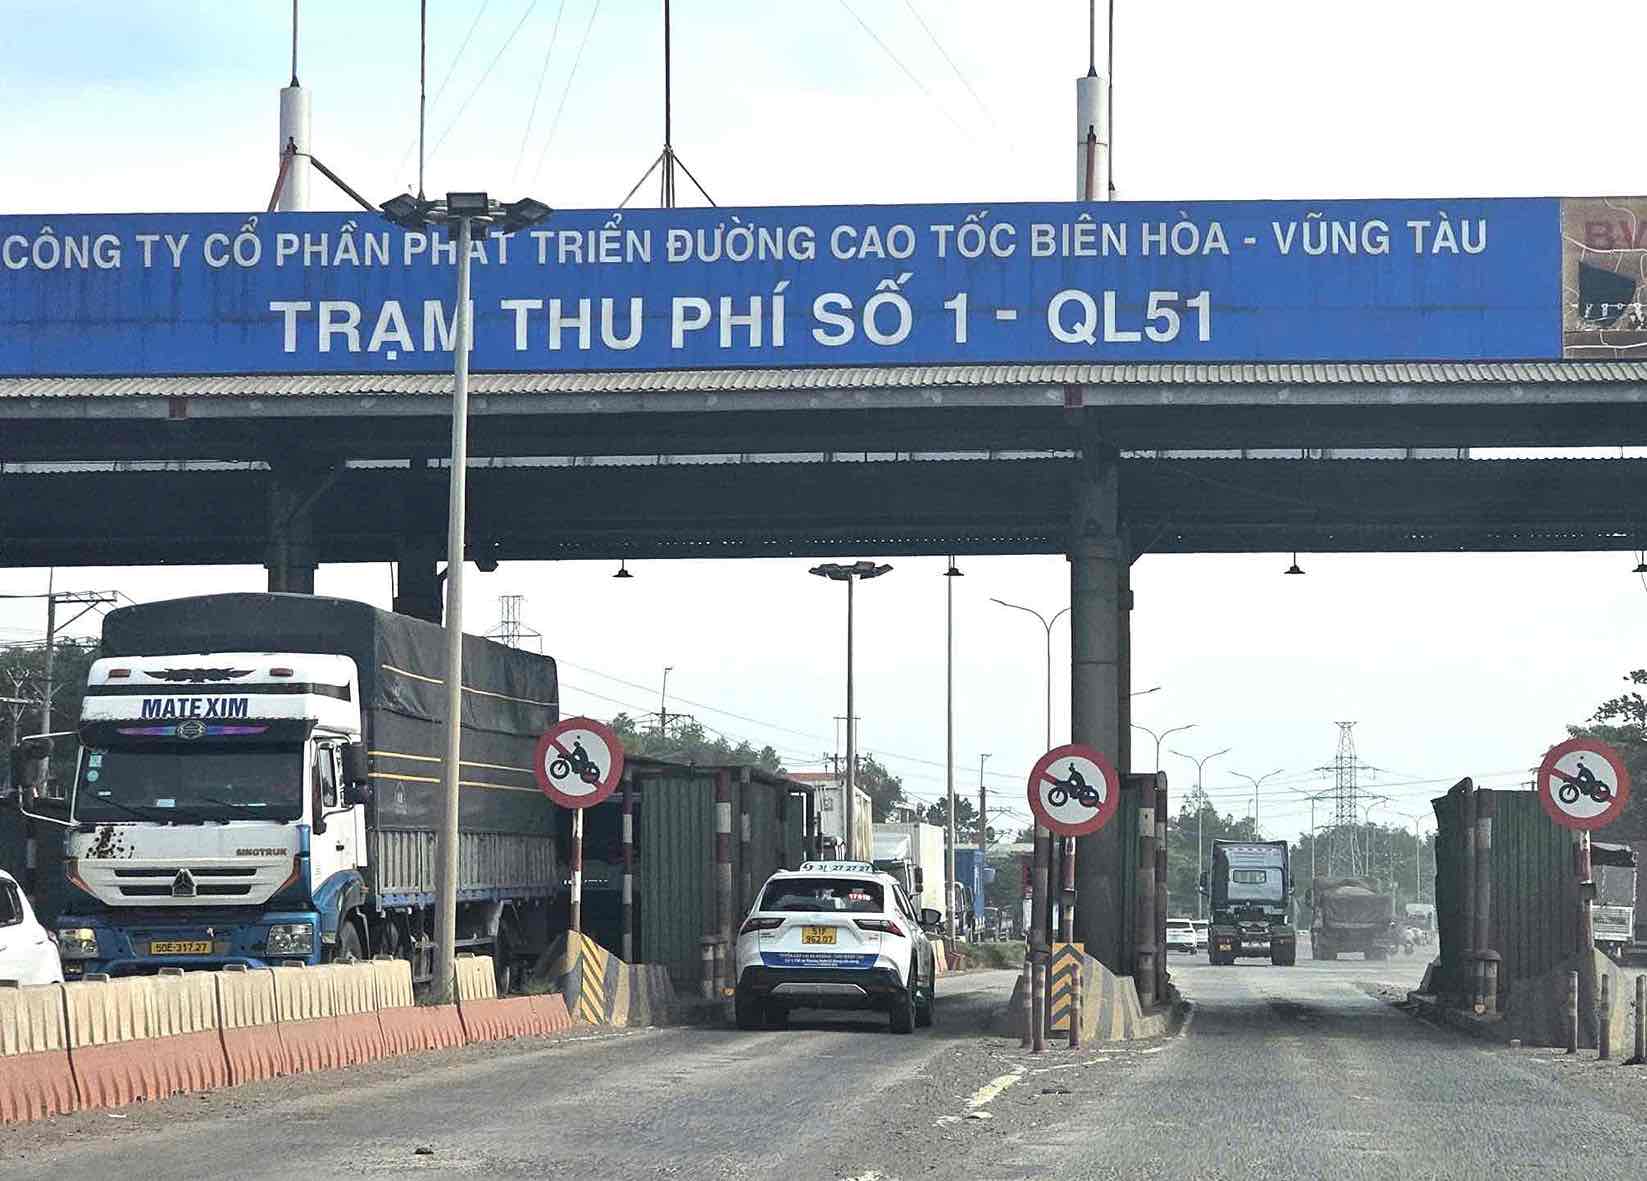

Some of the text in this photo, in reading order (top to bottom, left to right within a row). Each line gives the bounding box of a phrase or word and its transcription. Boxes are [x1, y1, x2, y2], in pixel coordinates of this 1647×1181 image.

[3, 226, 121, 269] CÔNG
[135, 232, 190, 267] TY
[203, 215, 262, 268] CỔ
[275, 220, 391, 267] PHẦN
[529, 212, 652, 265] TRIỂN
[665, 215, 817, 263] ĐƯỜNG
[830, 224, 916, 260] CAO
[930, 210, 1017, 258] TỐC
[1030, 212, 1127, 257] BIÊN
[1141, 210, 1230, 257] HÒA
[1243, 237, 1257, 247] -
[1271, 211, 1390, 257] VŨNG
[1406, 210, 1487, 257] TÀU
[269, 271, 1211, 361] TRẠM THU PHÍ SỐ 1 - QL51
[141, 697, 249, 718] MATEXIM
